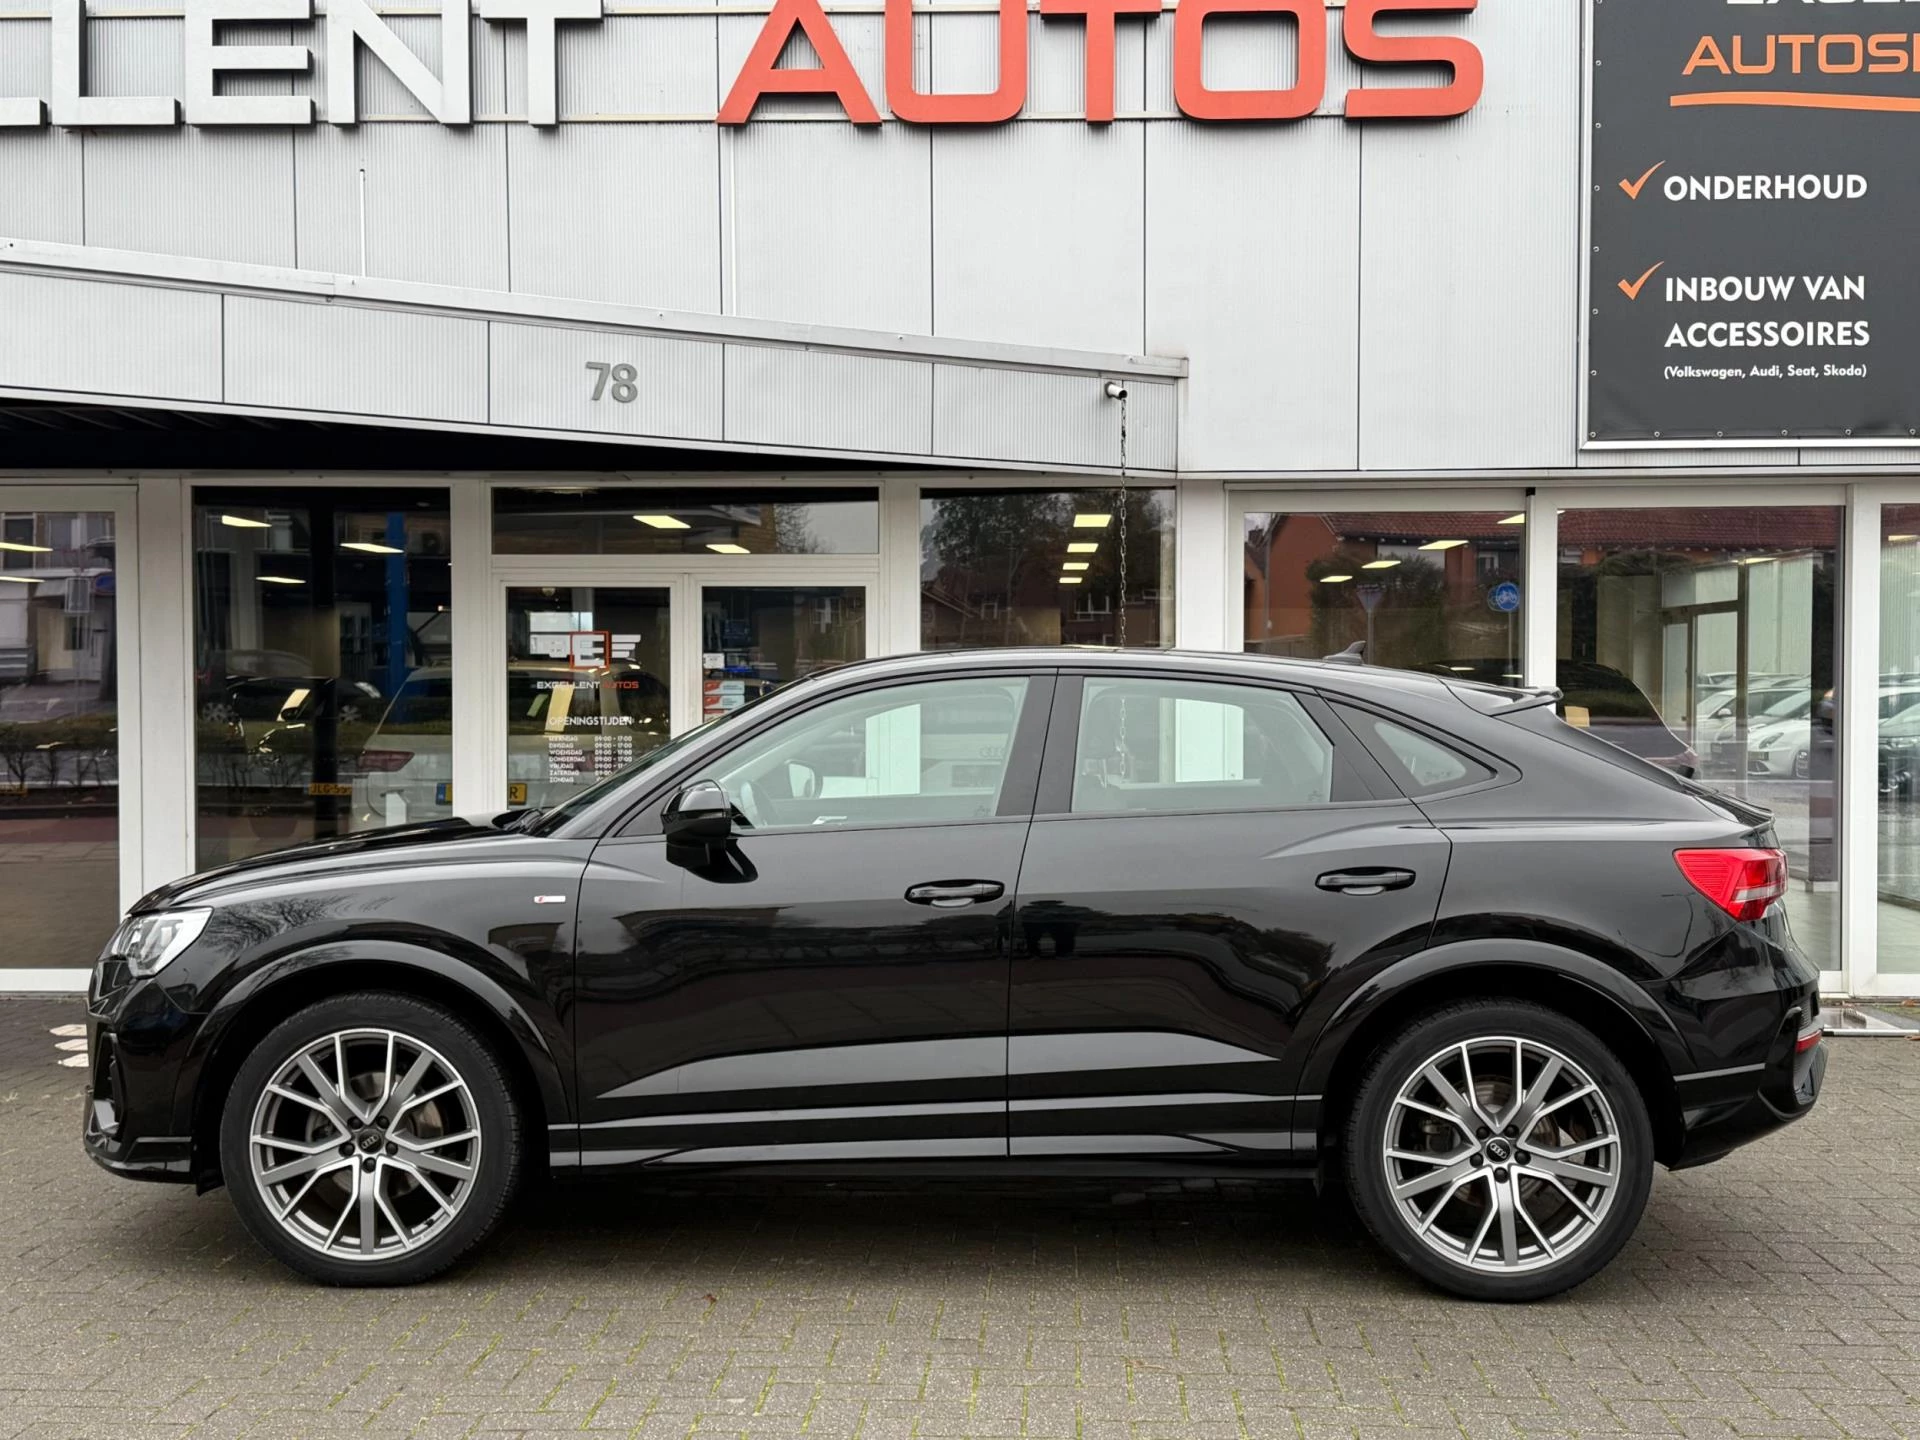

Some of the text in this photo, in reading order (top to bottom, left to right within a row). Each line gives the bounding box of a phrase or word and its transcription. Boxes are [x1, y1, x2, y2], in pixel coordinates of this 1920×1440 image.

[0, 0, 1484, 127] LENT AUTOS
[1682, 33, 1920, 75] AUTOS
[1663, 174, 1868, 201] ONDERHOUD
[1665, 275, 1865, 302] INBOUW VAN
[1664, 321, 1870, 348] ACCESSOIRES
[585, 361, 638, 404] 78
[1663, 364, 1867, 380] (Volkswagen, Audi, Seat, Skoda)
[603, 680, 639, 689] AUTOS
[549, 716, 632, 726] OPENINGSTIJDEN
